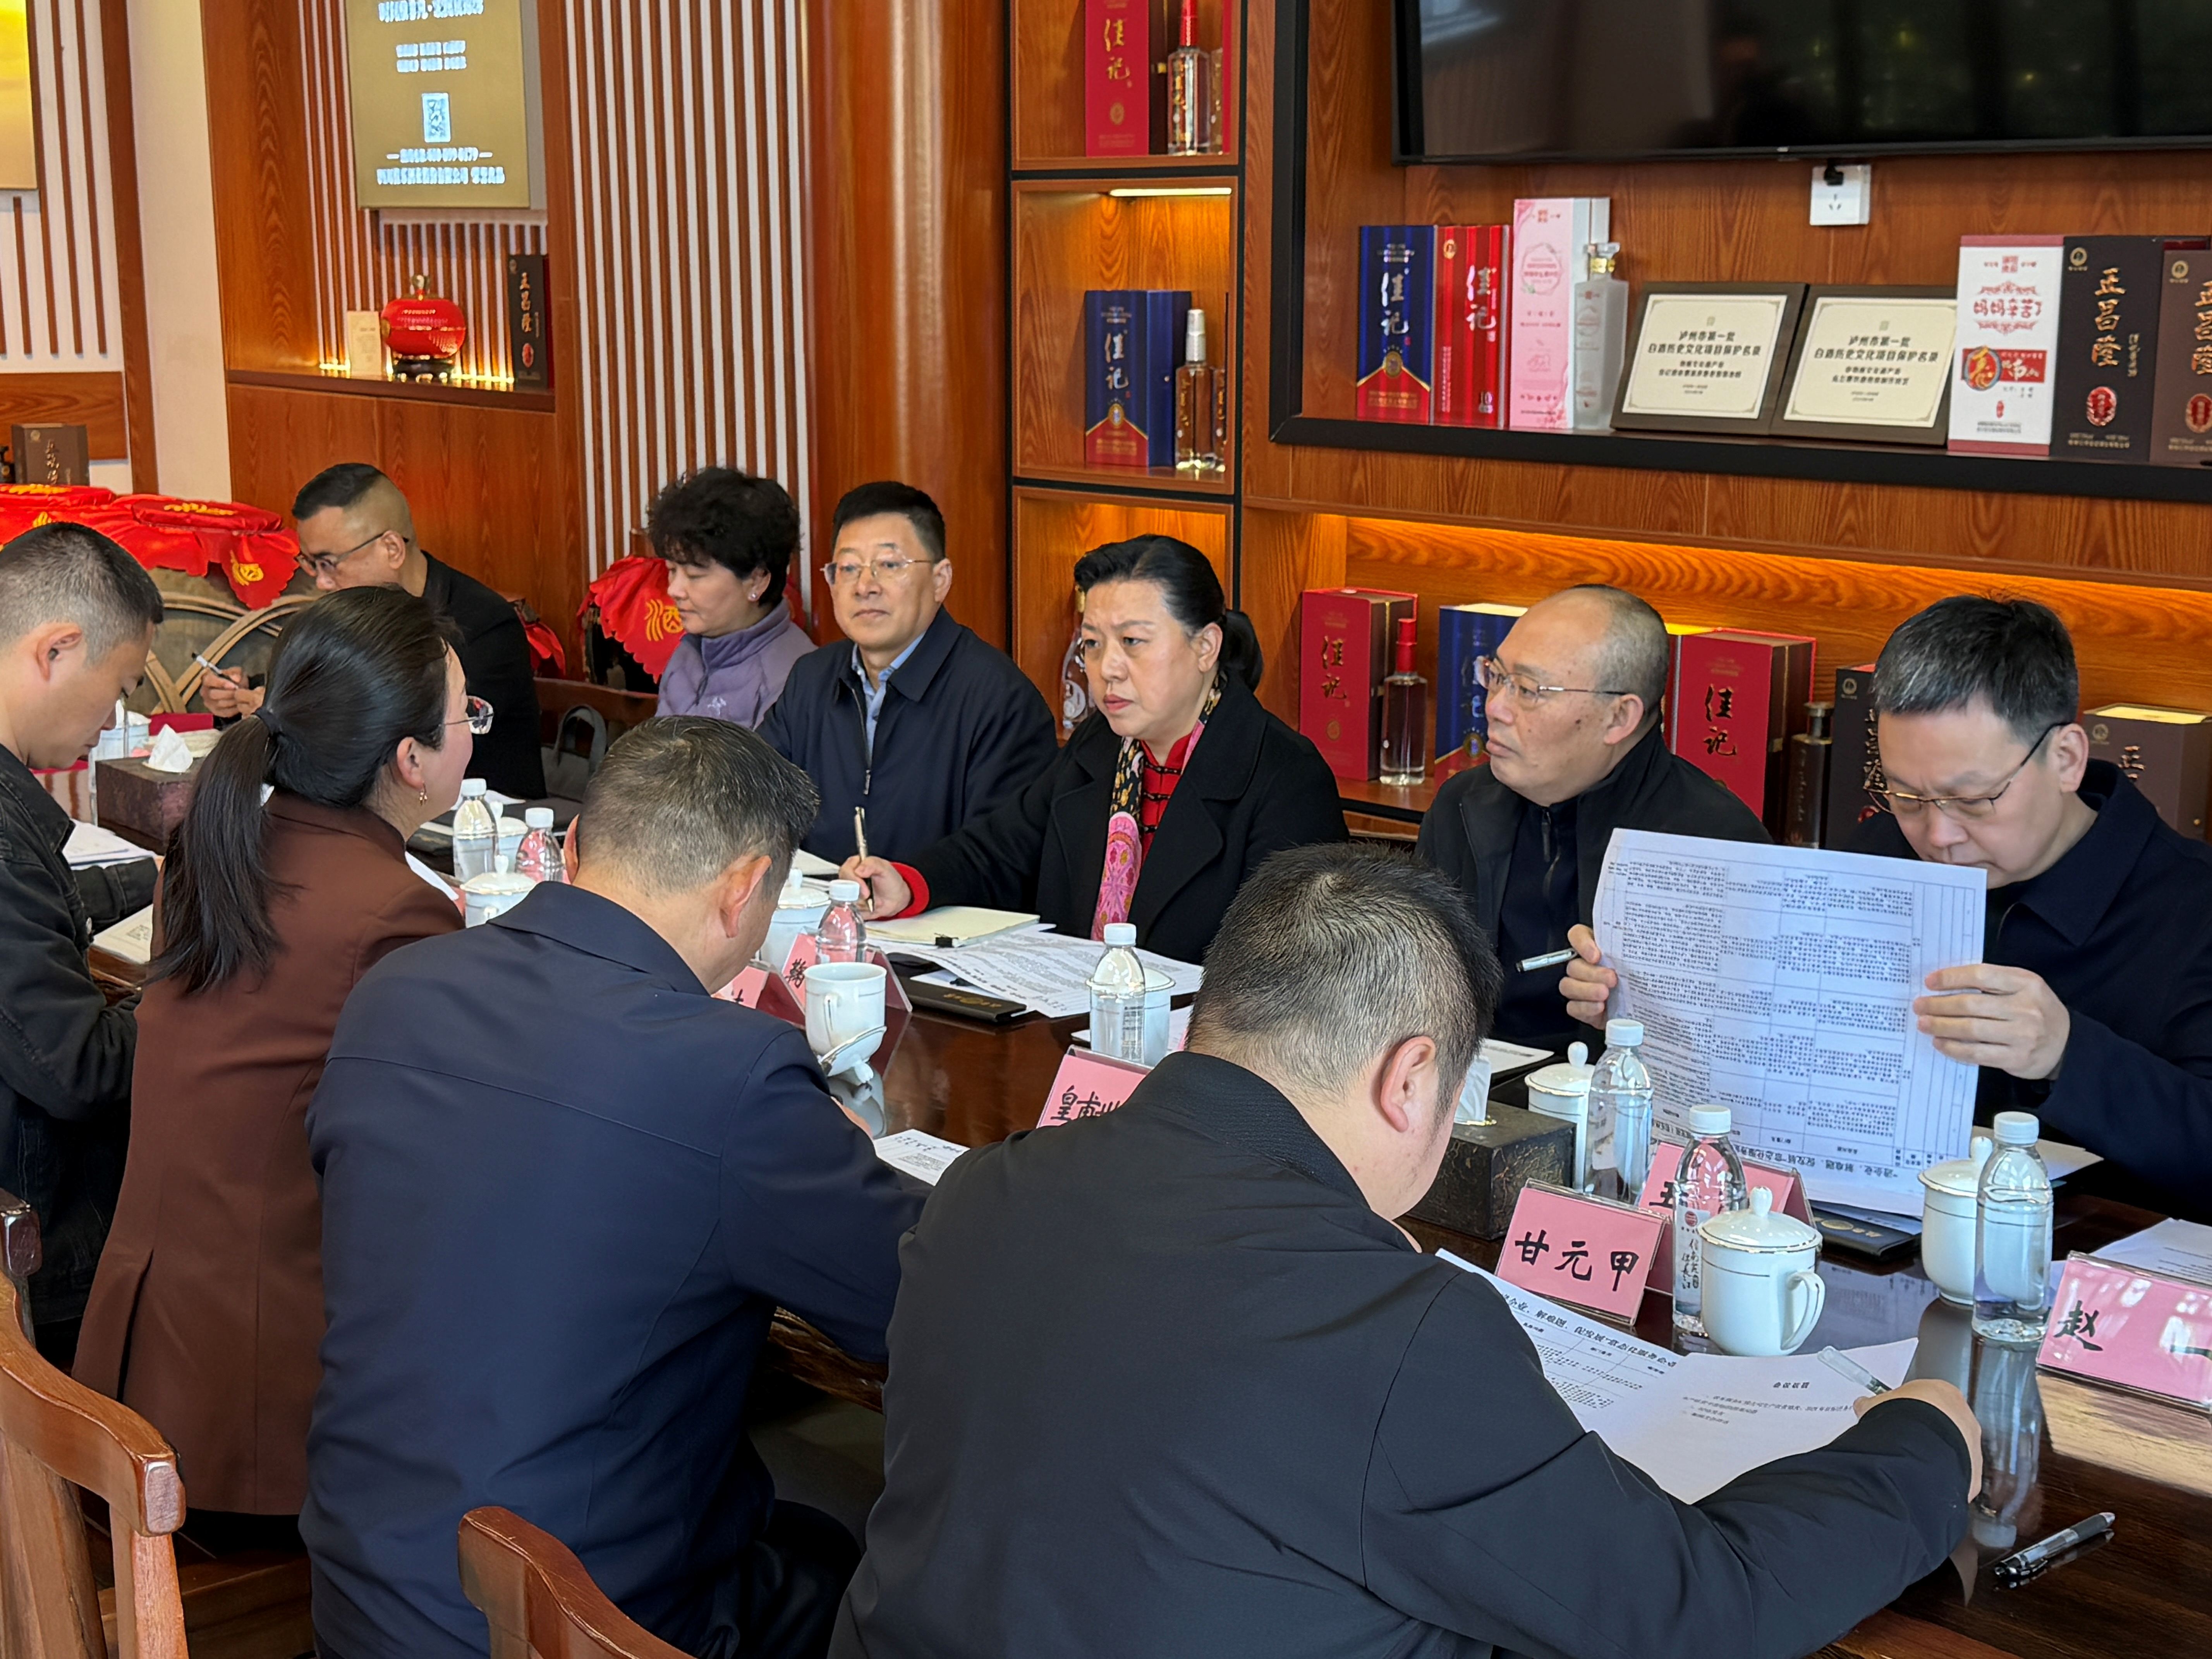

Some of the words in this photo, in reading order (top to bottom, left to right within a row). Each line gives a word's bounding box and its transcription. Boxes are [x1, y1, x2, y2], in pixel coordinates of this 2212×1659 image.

[1104, 19, 1130, 79] 汪记
[1381, 272, 1409, 336] 汪记
[1973, 298, 2043, 318] 妈妈辛苦了
[1105, 332, 1129, 390] 汪记
[1679, 331, 1735, 342] 泸州市第一批
[1848, 335, 1911, 347] 泸州市第一批
[1321, 635, 1347, 699] 汪记
[1704, 683, 1737, 756] 汪记
[1514, 1230, 1640, 1292] 甘元甲
[2053, 1300, 2104, 1352] 赵
